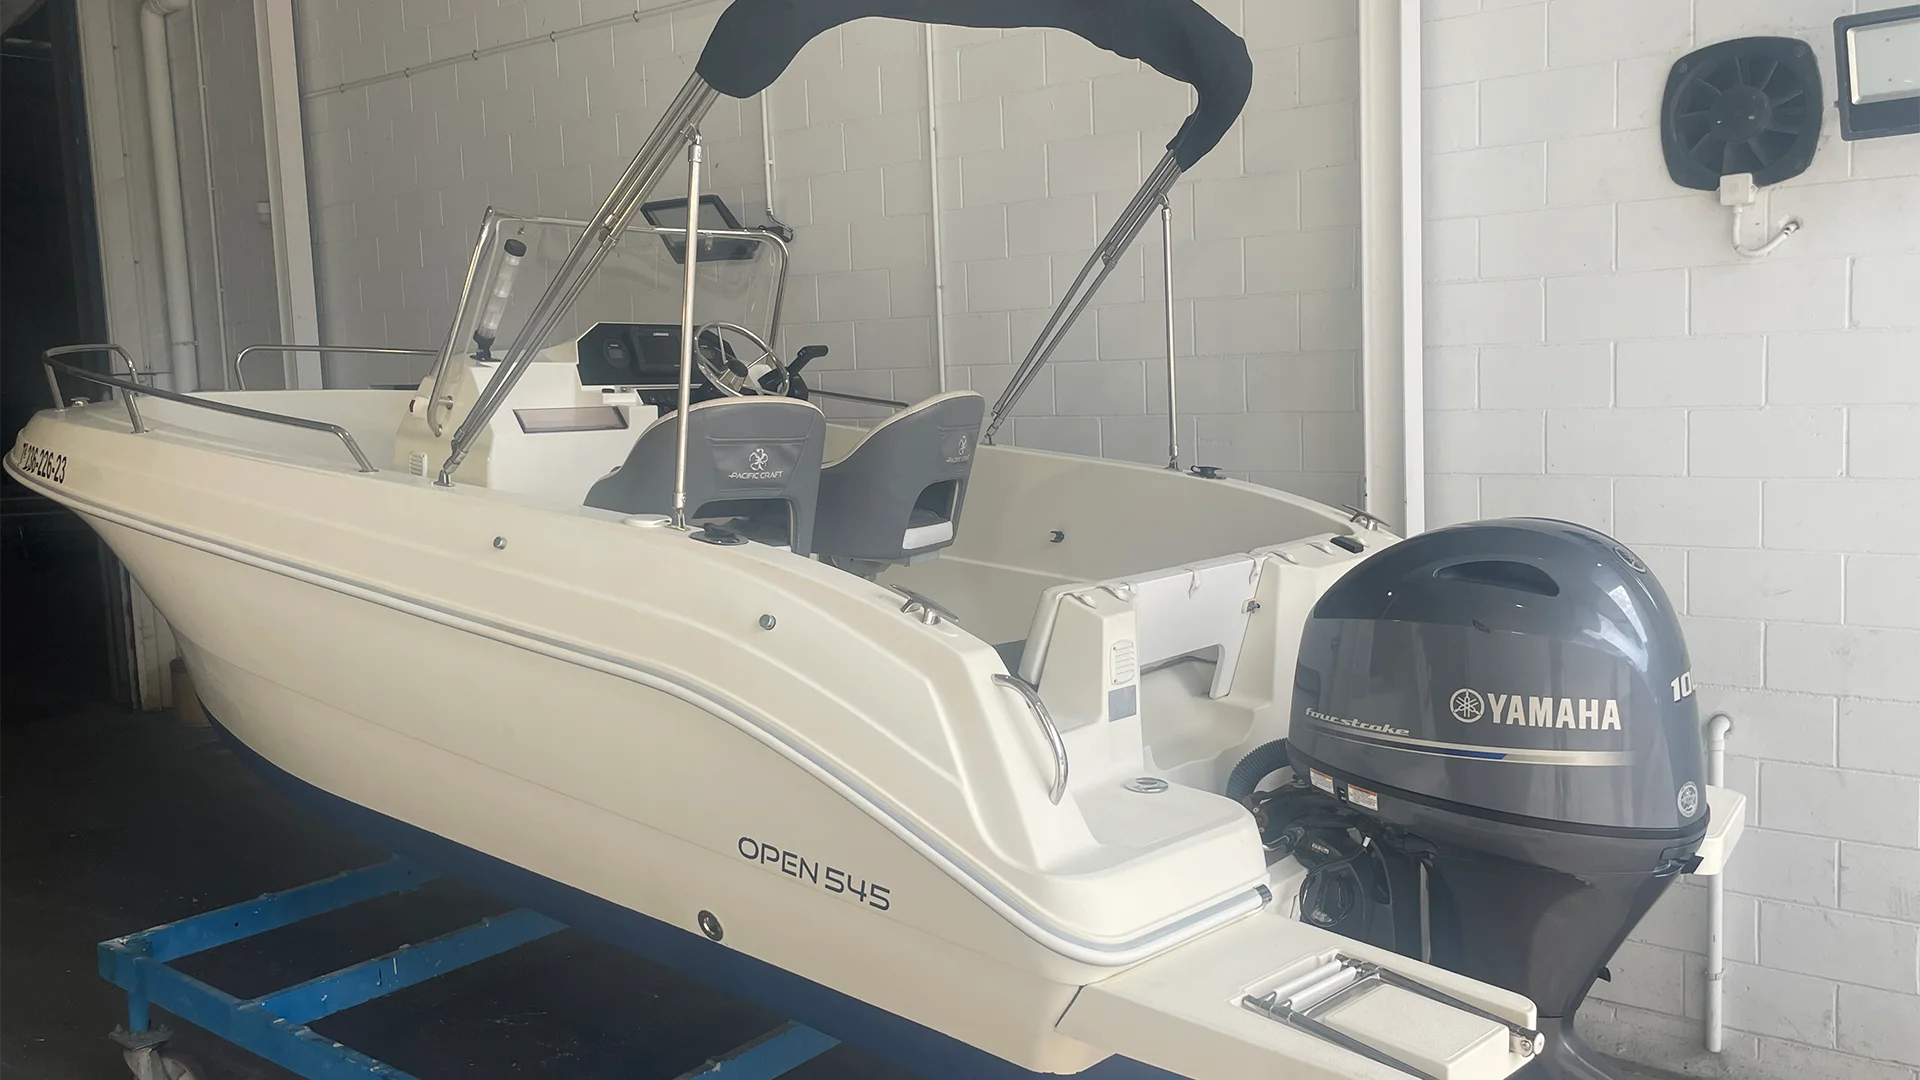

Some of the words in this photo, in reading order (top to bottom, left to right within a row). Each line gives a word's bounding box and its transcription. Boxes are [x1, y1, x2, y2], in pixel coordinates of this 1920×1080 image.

[760, 471, 784, 479] CRAFT
[1487, 693, 1621, 730] YAMAHA
[738, 837, 819, 884] OPEN
[825, 866, 890, 911] 545
